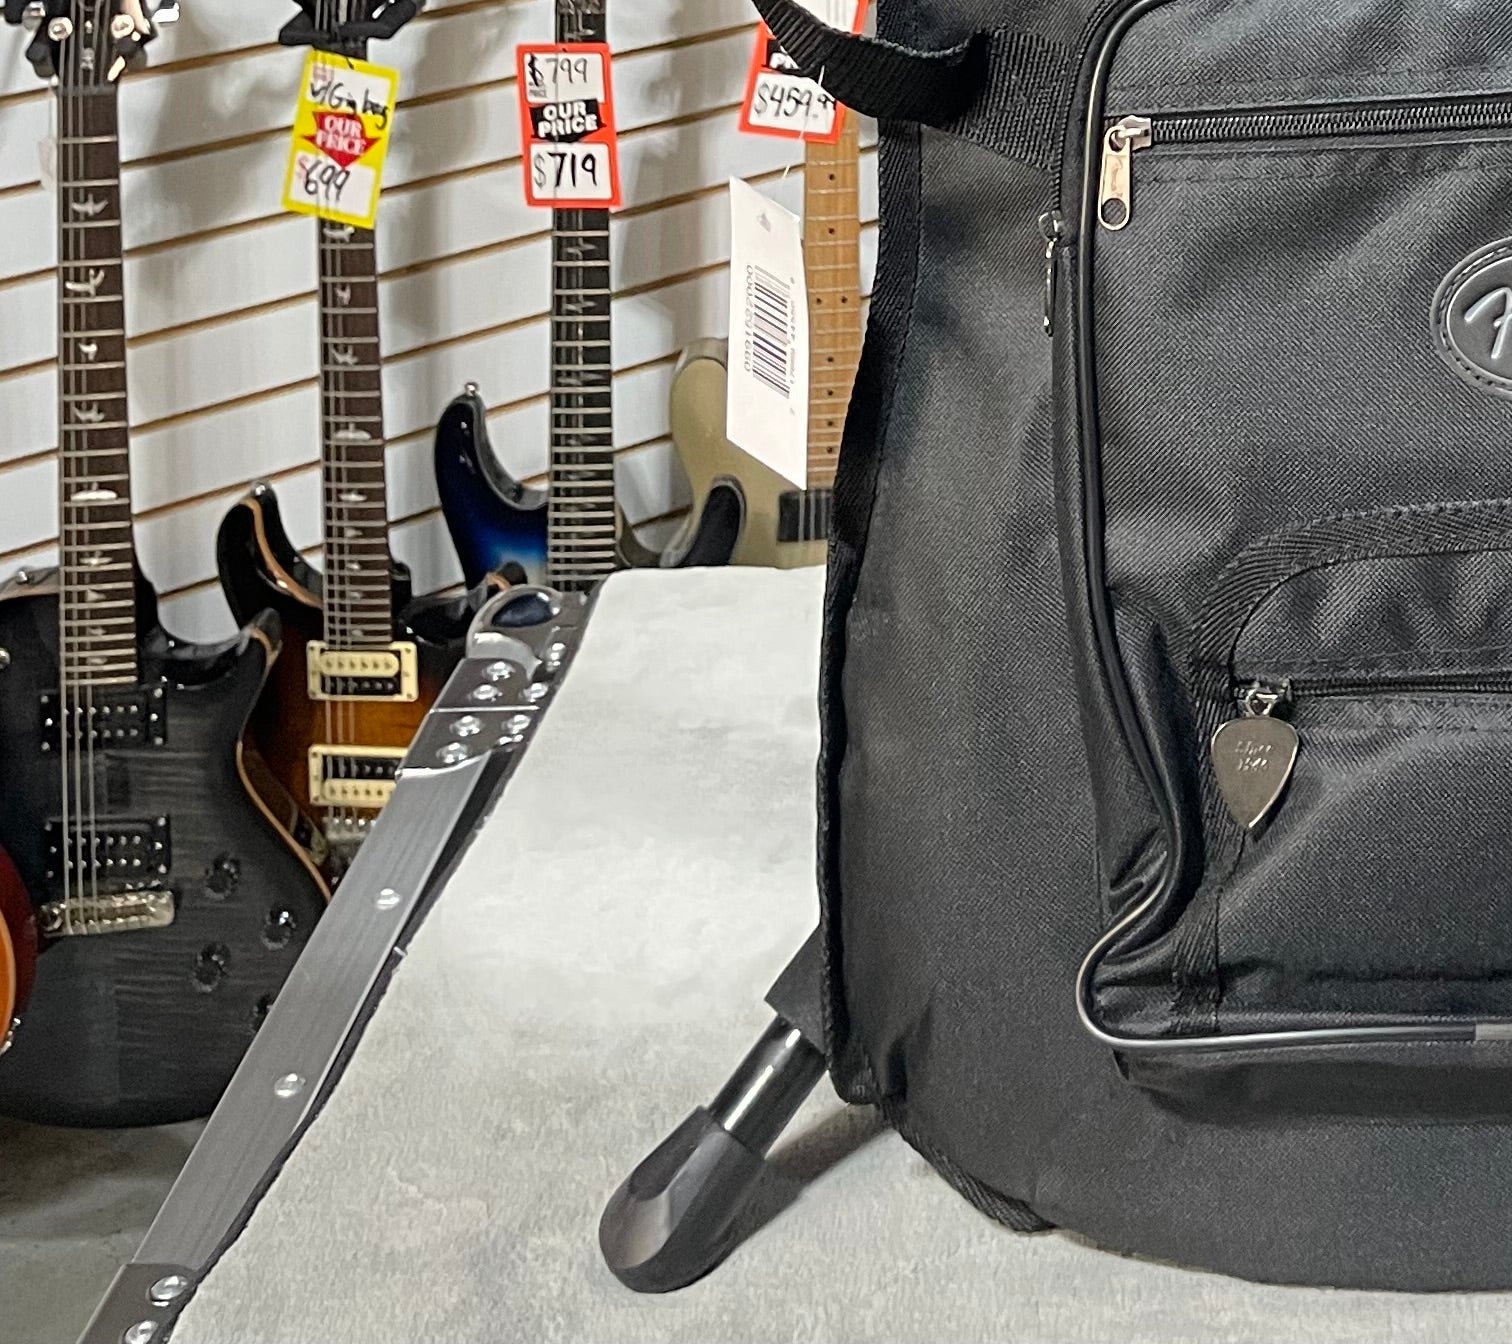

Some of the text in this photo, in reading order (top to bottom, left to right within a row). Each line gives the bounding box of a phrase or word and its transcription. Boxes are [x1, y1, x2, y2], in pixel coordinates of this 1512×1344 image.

[542, 100, 587, 120] OUR
[323, 114, 363, 139] OUR
[537, 114, 598, 138] PRICE
[315, 128, 367, 155] PRICE
[533, 152, 598, 190] $719
